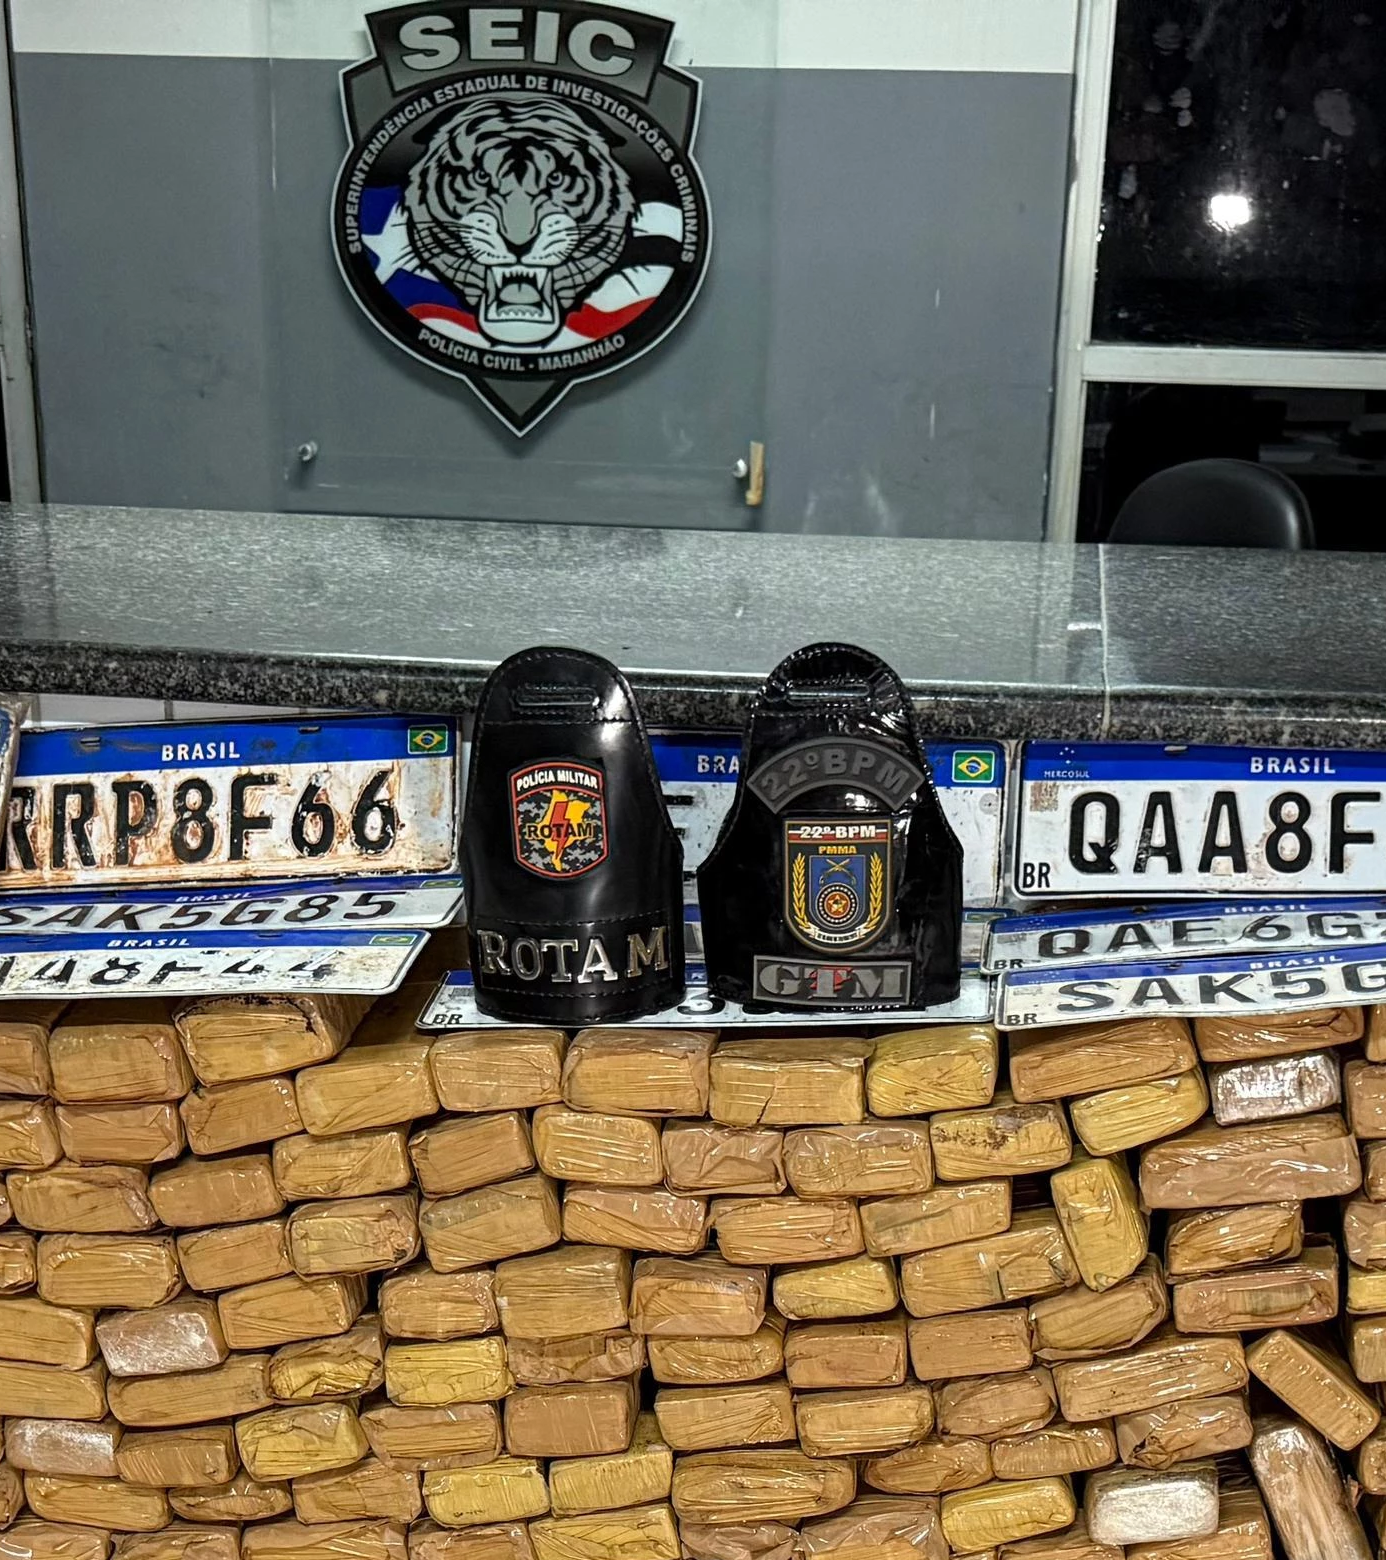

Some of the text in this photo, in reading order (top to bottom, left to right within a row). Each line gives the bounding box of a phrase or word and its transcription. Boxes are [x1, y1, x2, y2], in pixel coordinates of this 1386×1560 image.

[399, 8, 635, 75] SEIC
[346, 74, 696, 264] SUPERINTENDÊNCIA ESTADUAL DE INVESTIGAÇÕES CRIMINAIS
[418, 328, 479, 367] POLÍCIA
[483, 352, 525, 372] CIVIL
[538, 333, 626, 372] MARANHÃO
[161, 742, 240, 762] BRASIL
[697, 755, 740, 773] BRA
[1249, 756, 1336, 776] BRASIL
[516, 769, 598, 791] POLÍCIA MILITAR
[526, 822, 594, 839] ROTAM
[818, 845, 857, 854] PMMA
[1022, 862, 1051, 889] BR
[175, 892, 254, 903] BRASIL
[1224, 903, 1312, 914] BRASIL
[106, 937, 191, 948] BRASIL
[477, 925, 669, 984] ROTAM
[1249, 954, 1343, 970] BRASIL
[994, 958, 1024, 970] BR
[759, 964, 905, 999] GTM
[432, 1013, 463, 1026] BR
[1007, 1013, 1038, 1026] BR
